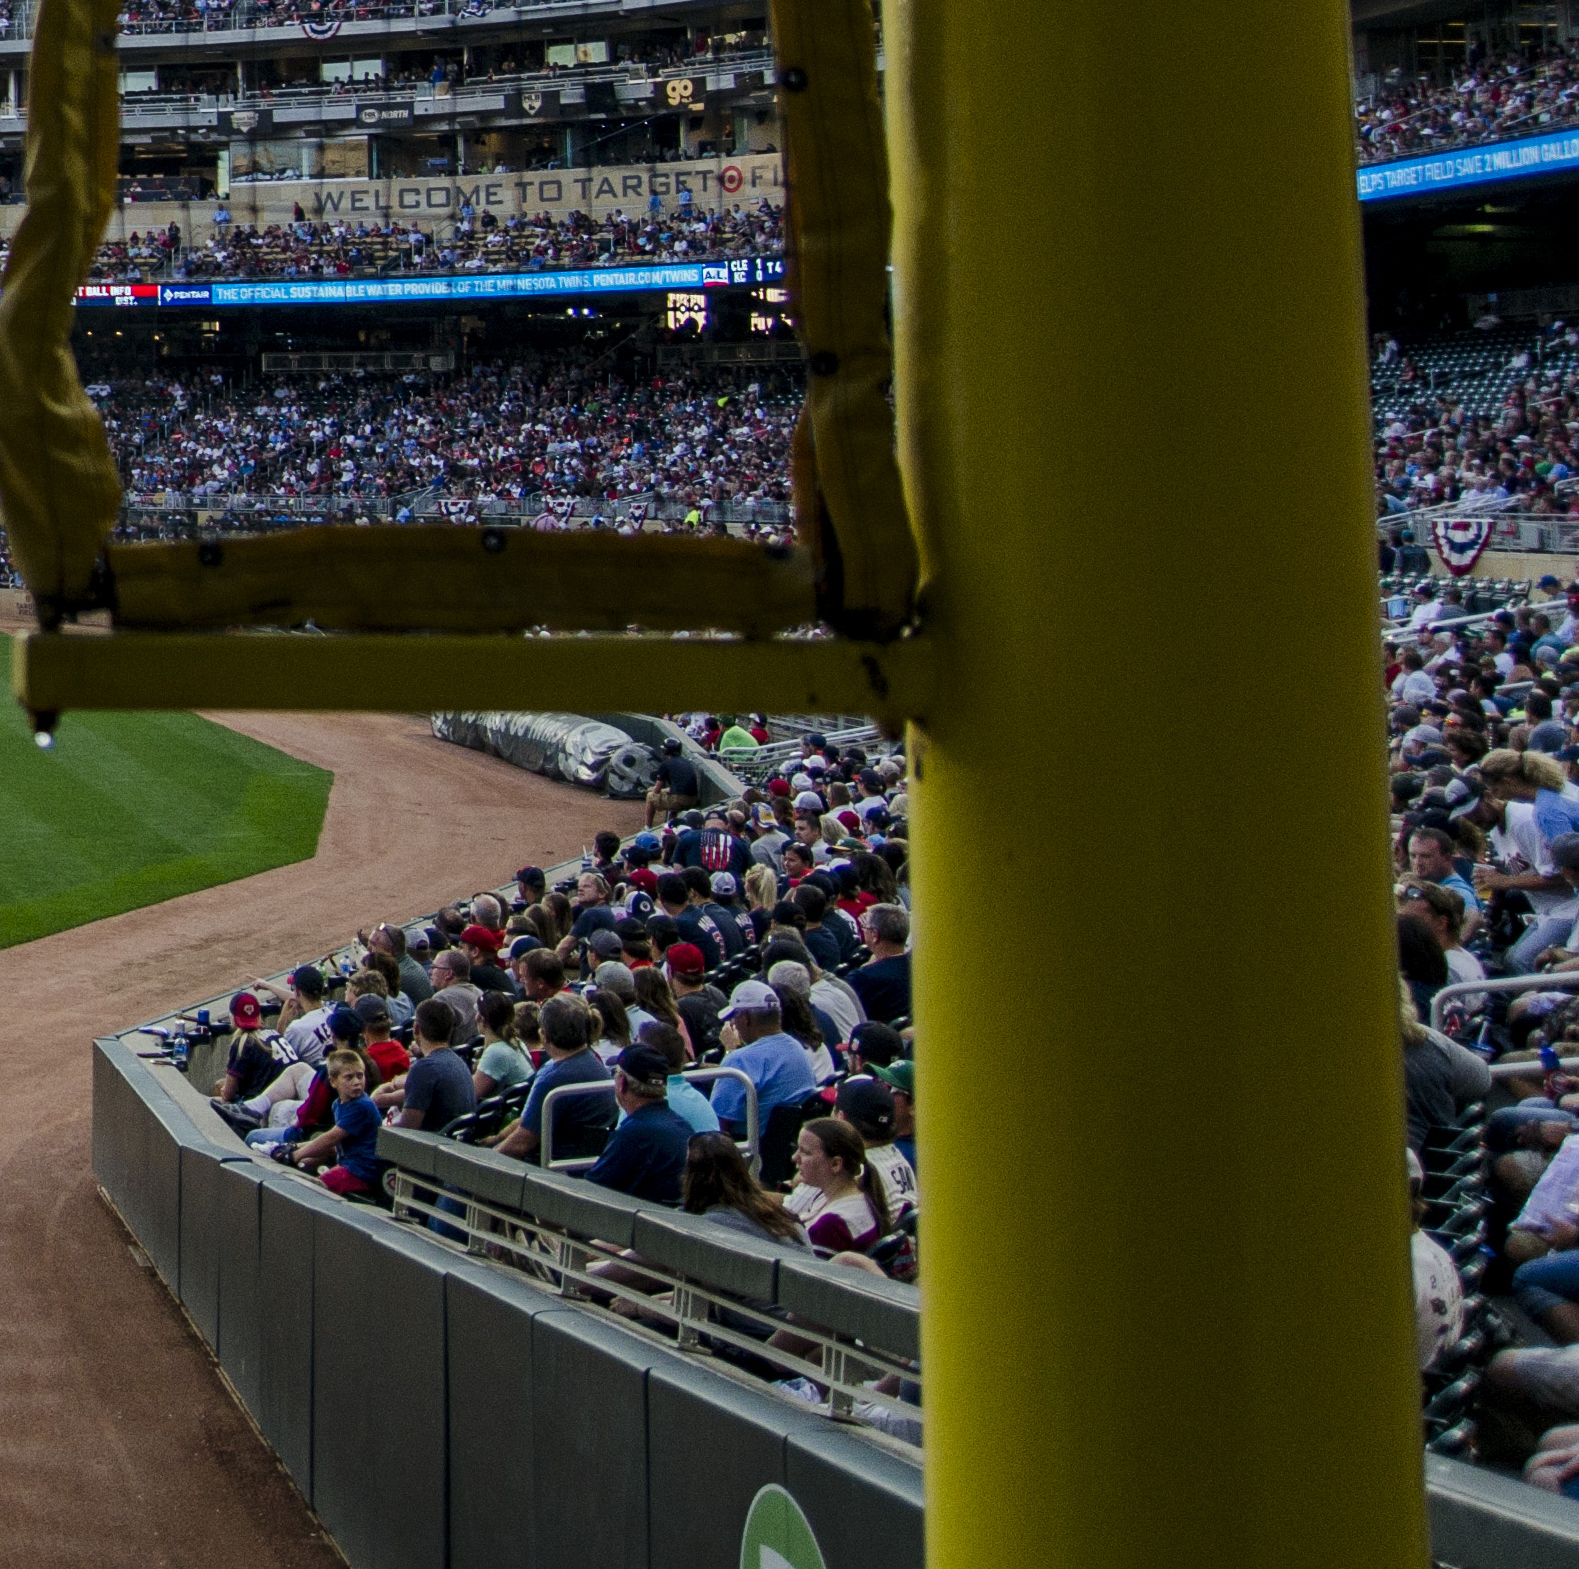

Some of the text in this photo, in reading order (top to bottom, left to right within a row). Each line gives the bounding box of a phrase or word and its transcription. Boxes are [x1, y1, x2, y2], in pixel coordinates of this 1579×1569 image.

[1359, 138, 1579, 194] ELPS TARGET FIELD SAVE 2 MILLION GALLO
[314, 182, 504, 213] WELCOME
[515, 179, 563, 204] TO
[567, 169, 715, 200] TARGET
[731, 259, 749, 272] CLE
[756, 258, 762, 270] 1
[217, 288, 240, 301] THE
[240, 287, 288, 300] OFFICIAL
[290, 284, 365, 298] SUSTAINABLE
[367, 283, 403, 296] WATER
[458, 280, 472, 293] OF
[474, 279, 495, 292] THE
[497, 277, 557, 290] MINNESOTA
[593, 269, 698, 287] PENTAIR.COM/TWINS
[733, 270, 763, 283] KC 0
[85, 286, 109, 297] BALL
[110, 286, 132, 297] INFO
[173, 289, 210, 300] PENTAIR
[270, 1036, 299, 1065] 48
